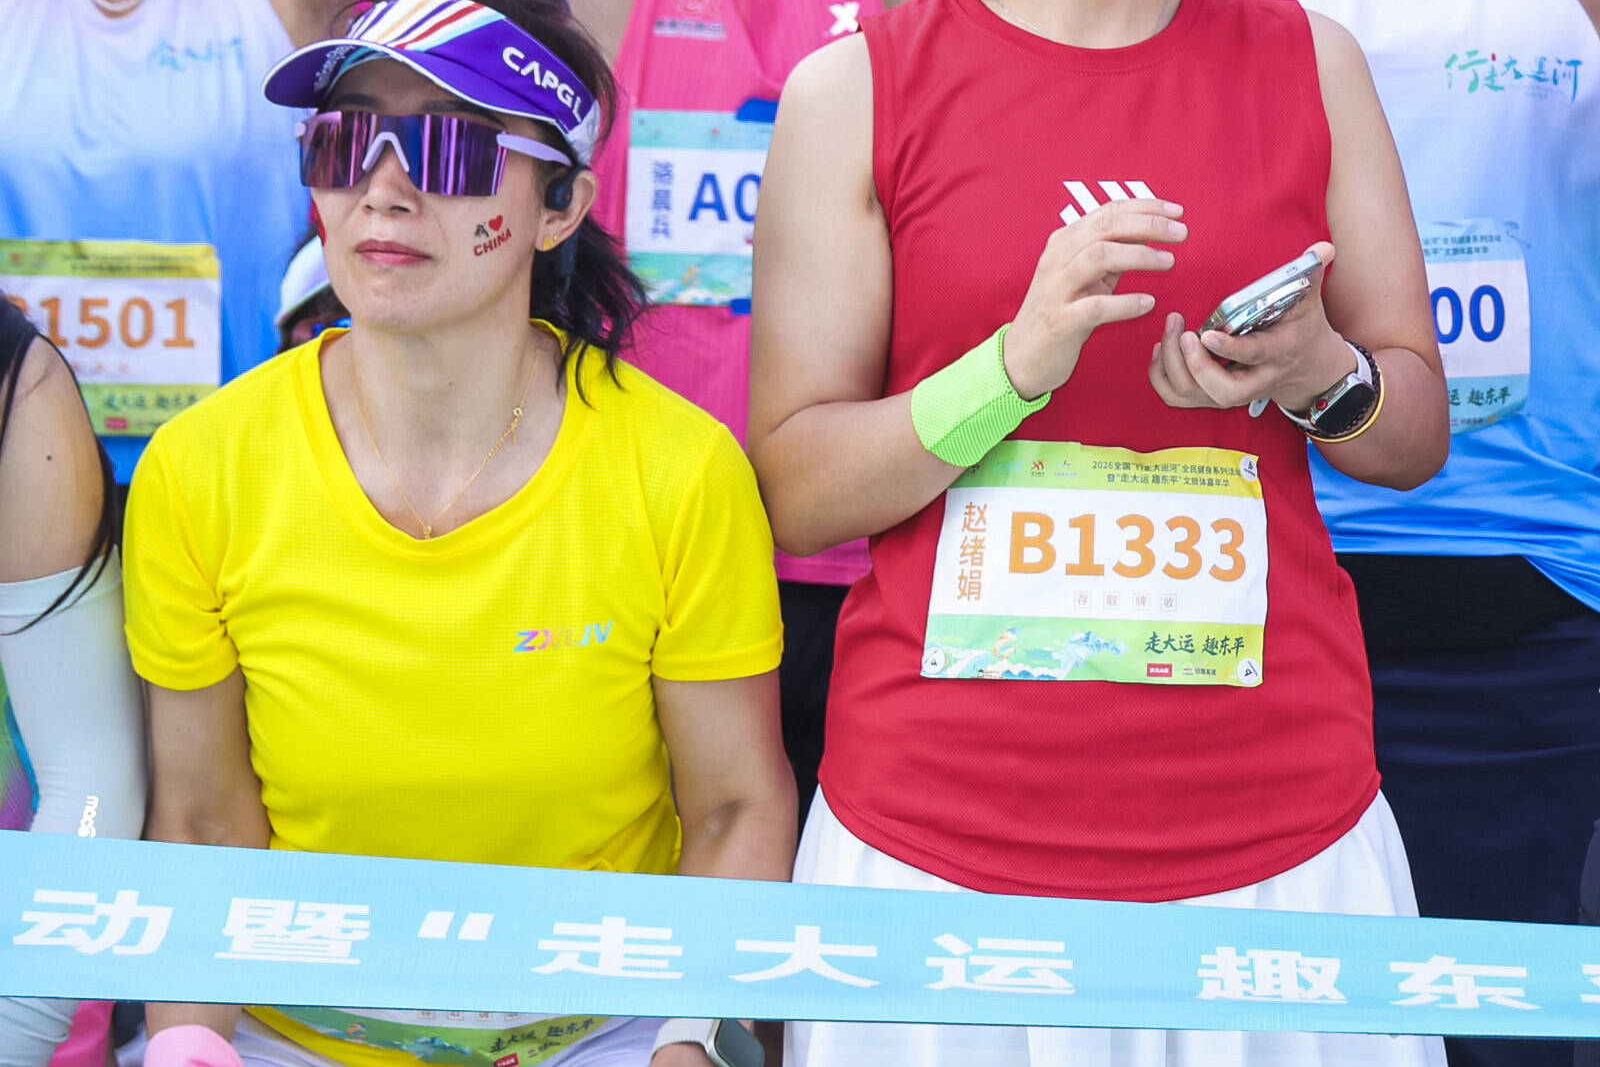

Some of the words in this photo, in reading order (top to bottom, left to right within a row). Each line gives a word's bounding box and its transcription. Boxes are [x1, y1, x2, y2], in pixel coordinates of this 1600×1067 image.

[473, 227, 512, 256] CHINA
[10, 296, 196, 350] 1501
[957, 502, 987, 602] 赵绪娟
[1009, 511, 1247, 582] B1333
[1144, 631, 1196, 655] 走大运
[1202, 635, 1245, 657] 趣东平
